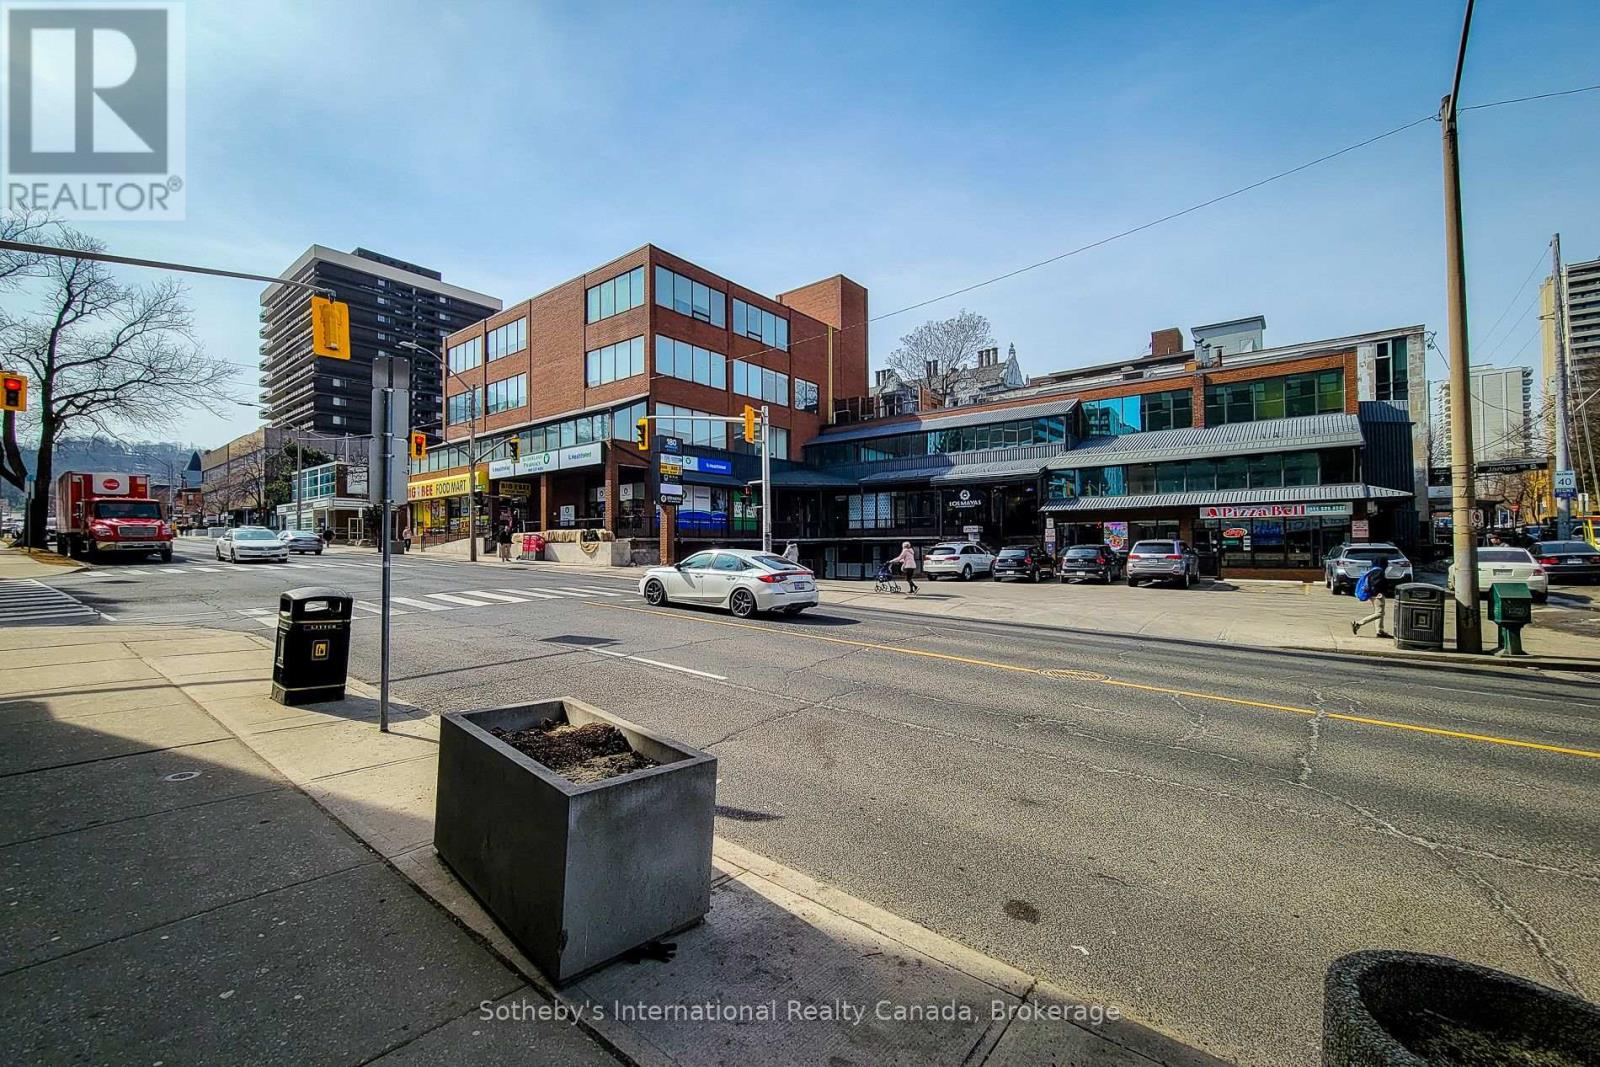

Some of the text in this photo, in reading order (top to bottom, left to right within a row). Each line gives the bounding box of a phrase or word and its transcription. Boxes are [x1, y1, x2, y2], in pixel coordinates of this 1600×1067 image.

[1558, 477, 1572, 486] 40
[421, 484, 433, 497] BEE
[1222, 507, 1268, 518] Pizza
[1271, 505, 1306, 517] Bell
